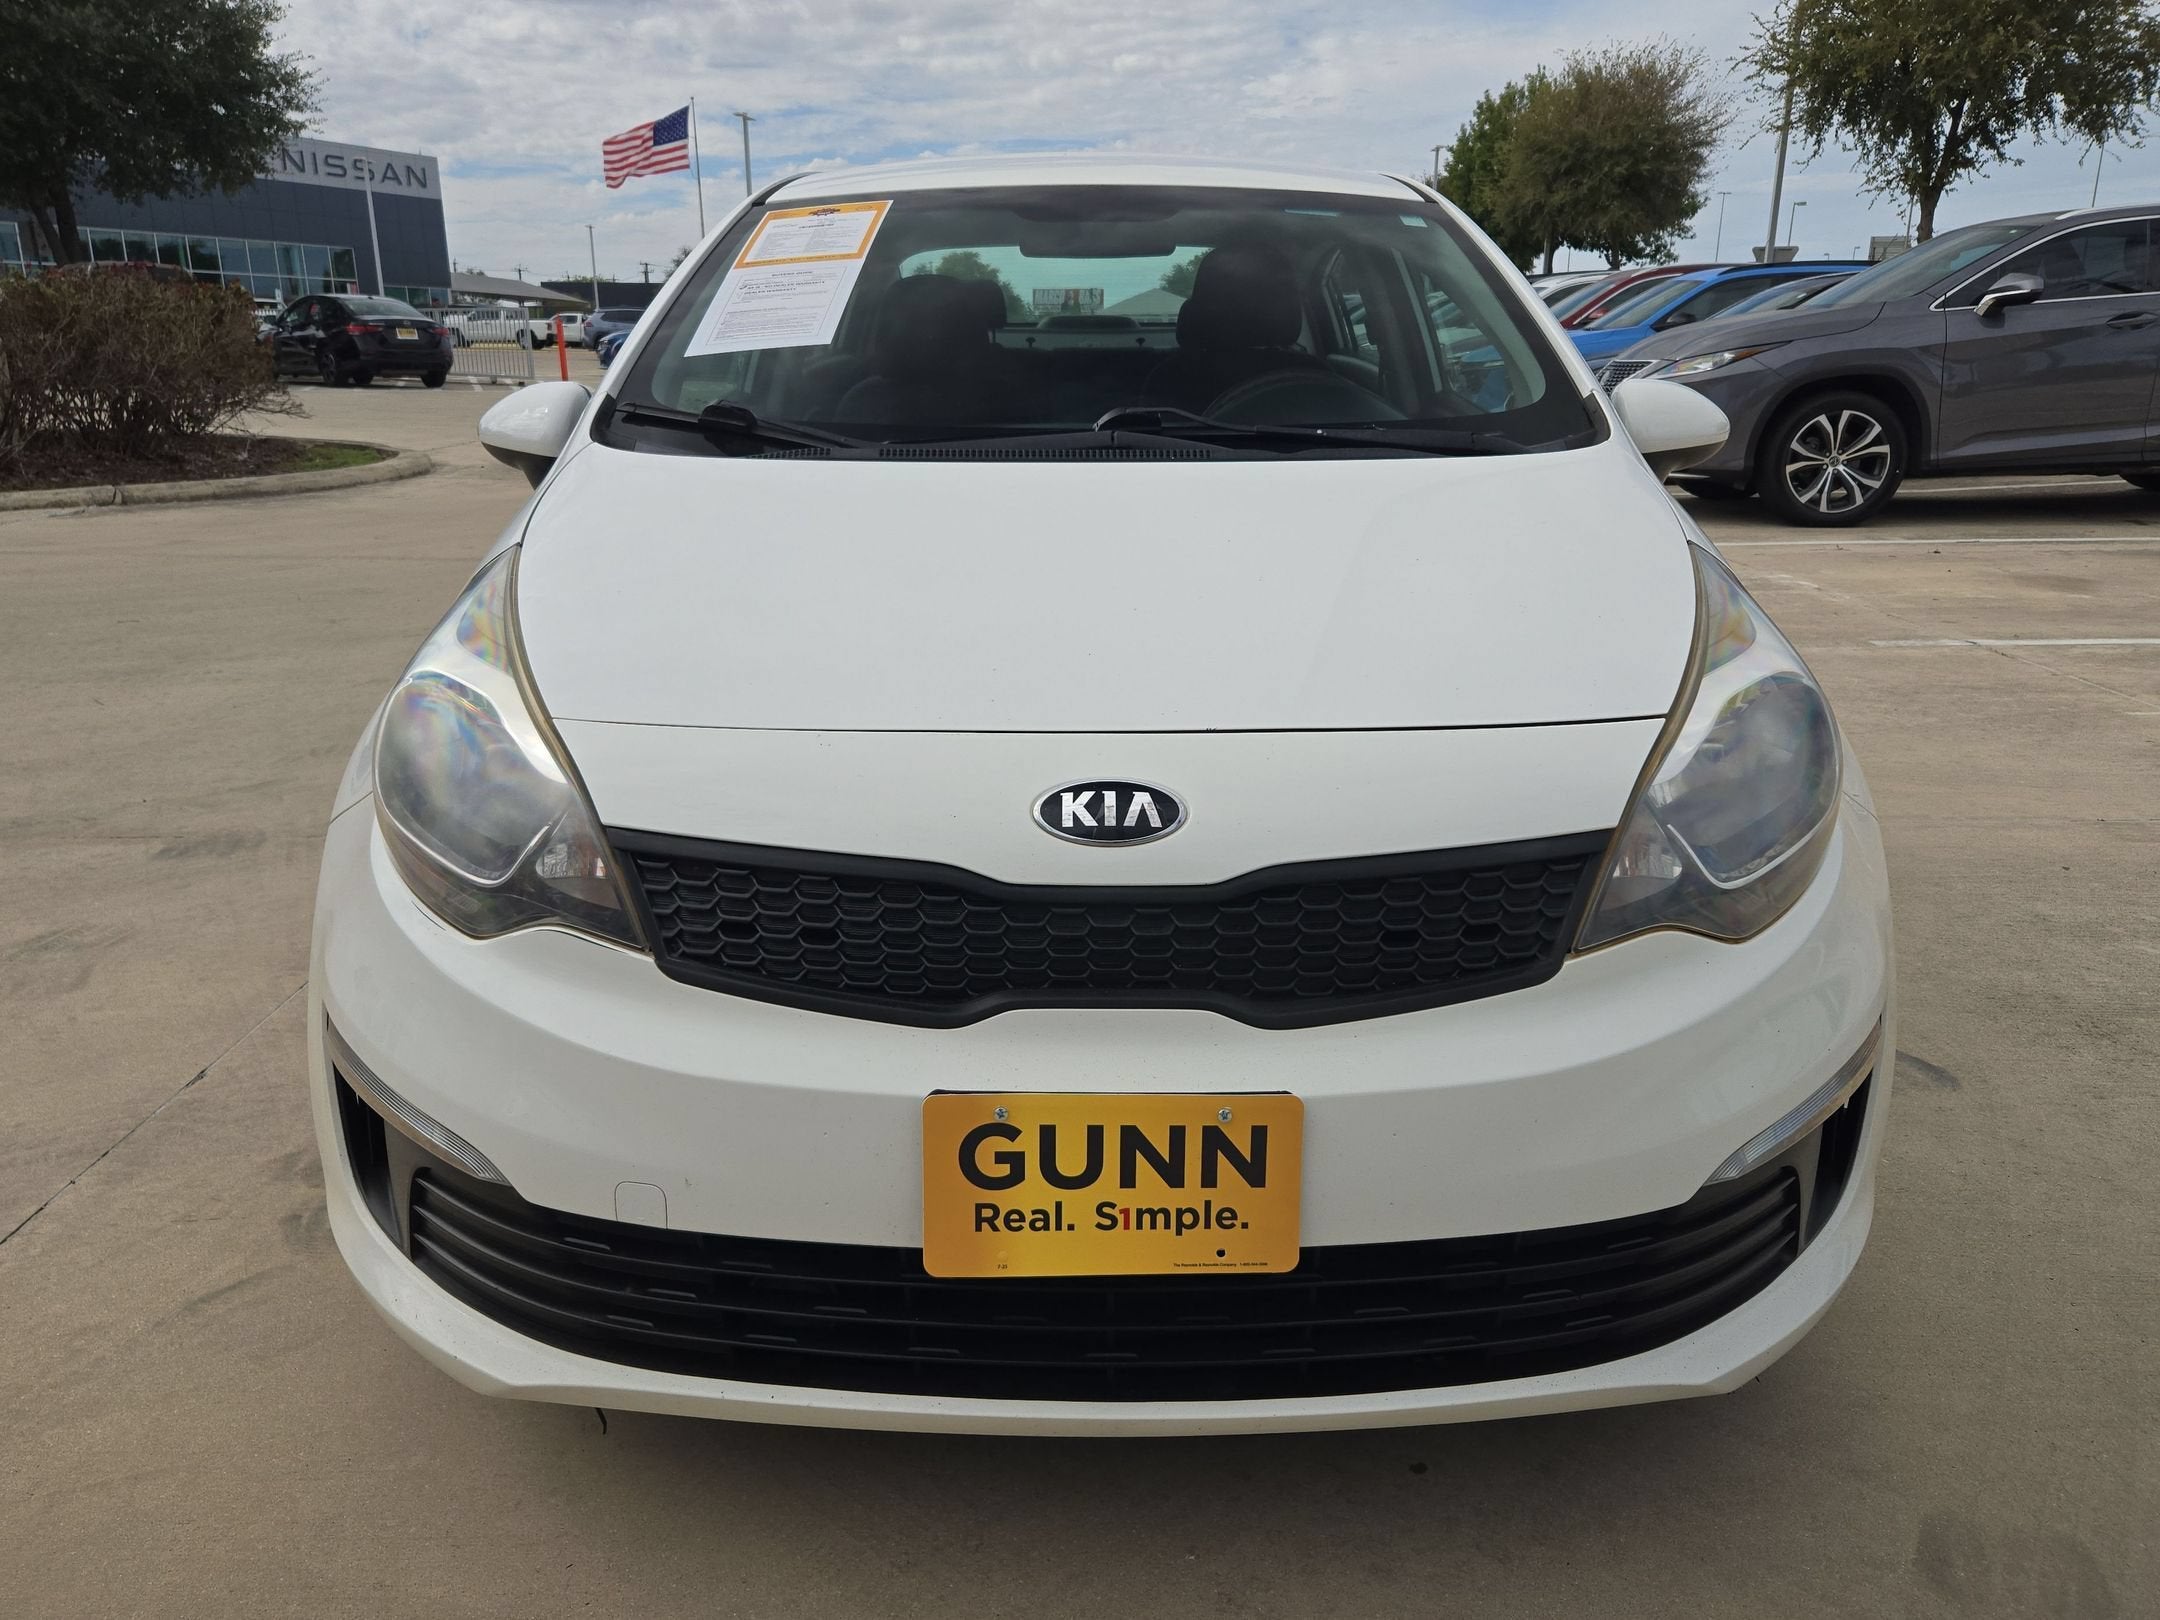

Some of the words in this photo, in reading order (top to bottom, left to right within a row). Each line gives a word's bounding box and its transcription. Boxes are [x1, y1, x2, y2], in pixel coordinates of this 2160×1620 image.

[281, 150, 428, 189] NISSAN
[1060, 790, 1163, 828] KIA
[958, 1122, 1269, 1191] GUNN
[974, 1200, 1075, 1233] Real.
